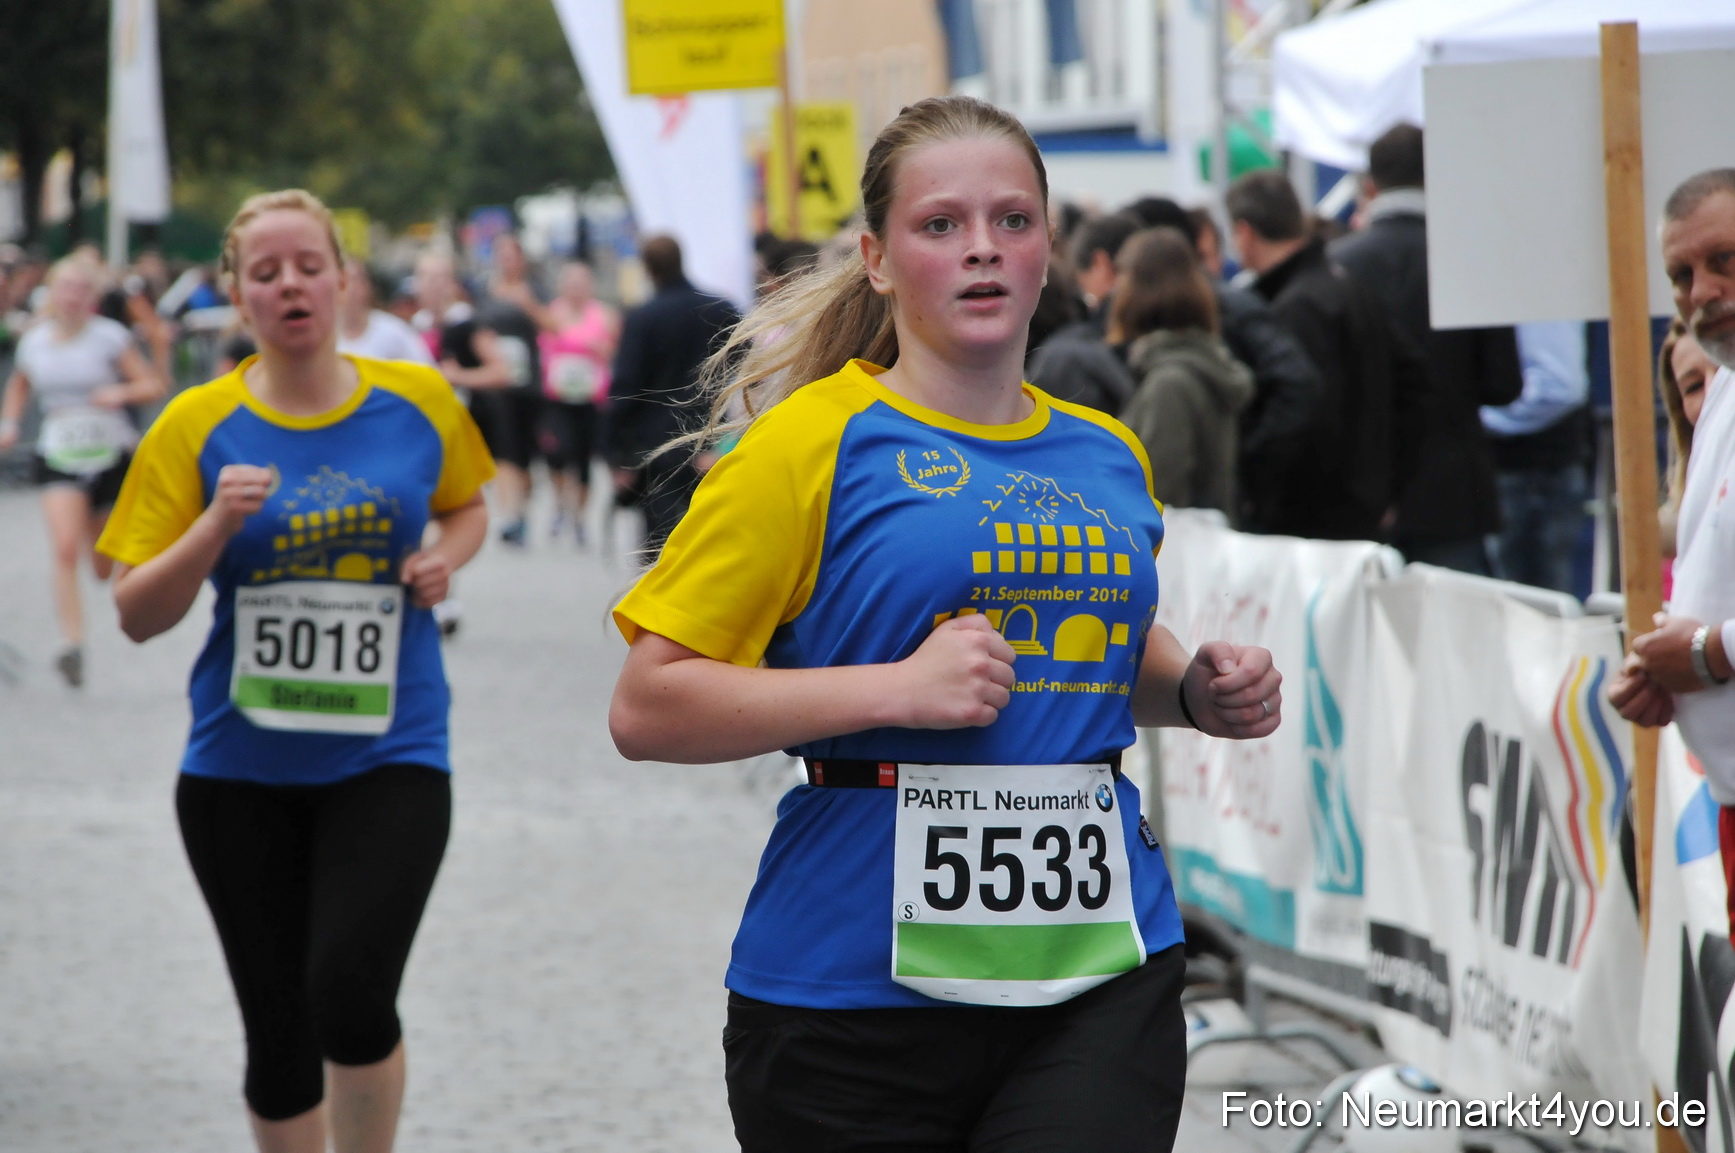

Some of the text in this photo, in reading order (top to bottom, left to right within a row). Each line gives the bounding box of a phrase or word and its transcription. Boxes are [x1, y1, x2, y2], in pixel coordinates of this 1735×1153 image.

[796, 147, 838, 202] A
[922, 450, 940, 461] 15
[918, 464, 958, 479] Jahre
[970, 585, 1130, 603] 21.September 2014
[255, 616, 381, 673] 5018
[1007, 677, 1130, 696] lauf-neumarkt.de
[903, 788, 1090, 811] PARTL Neumarkt
[923, 823, 1112, 913] 5533
[903, 904, 914, 920] S
